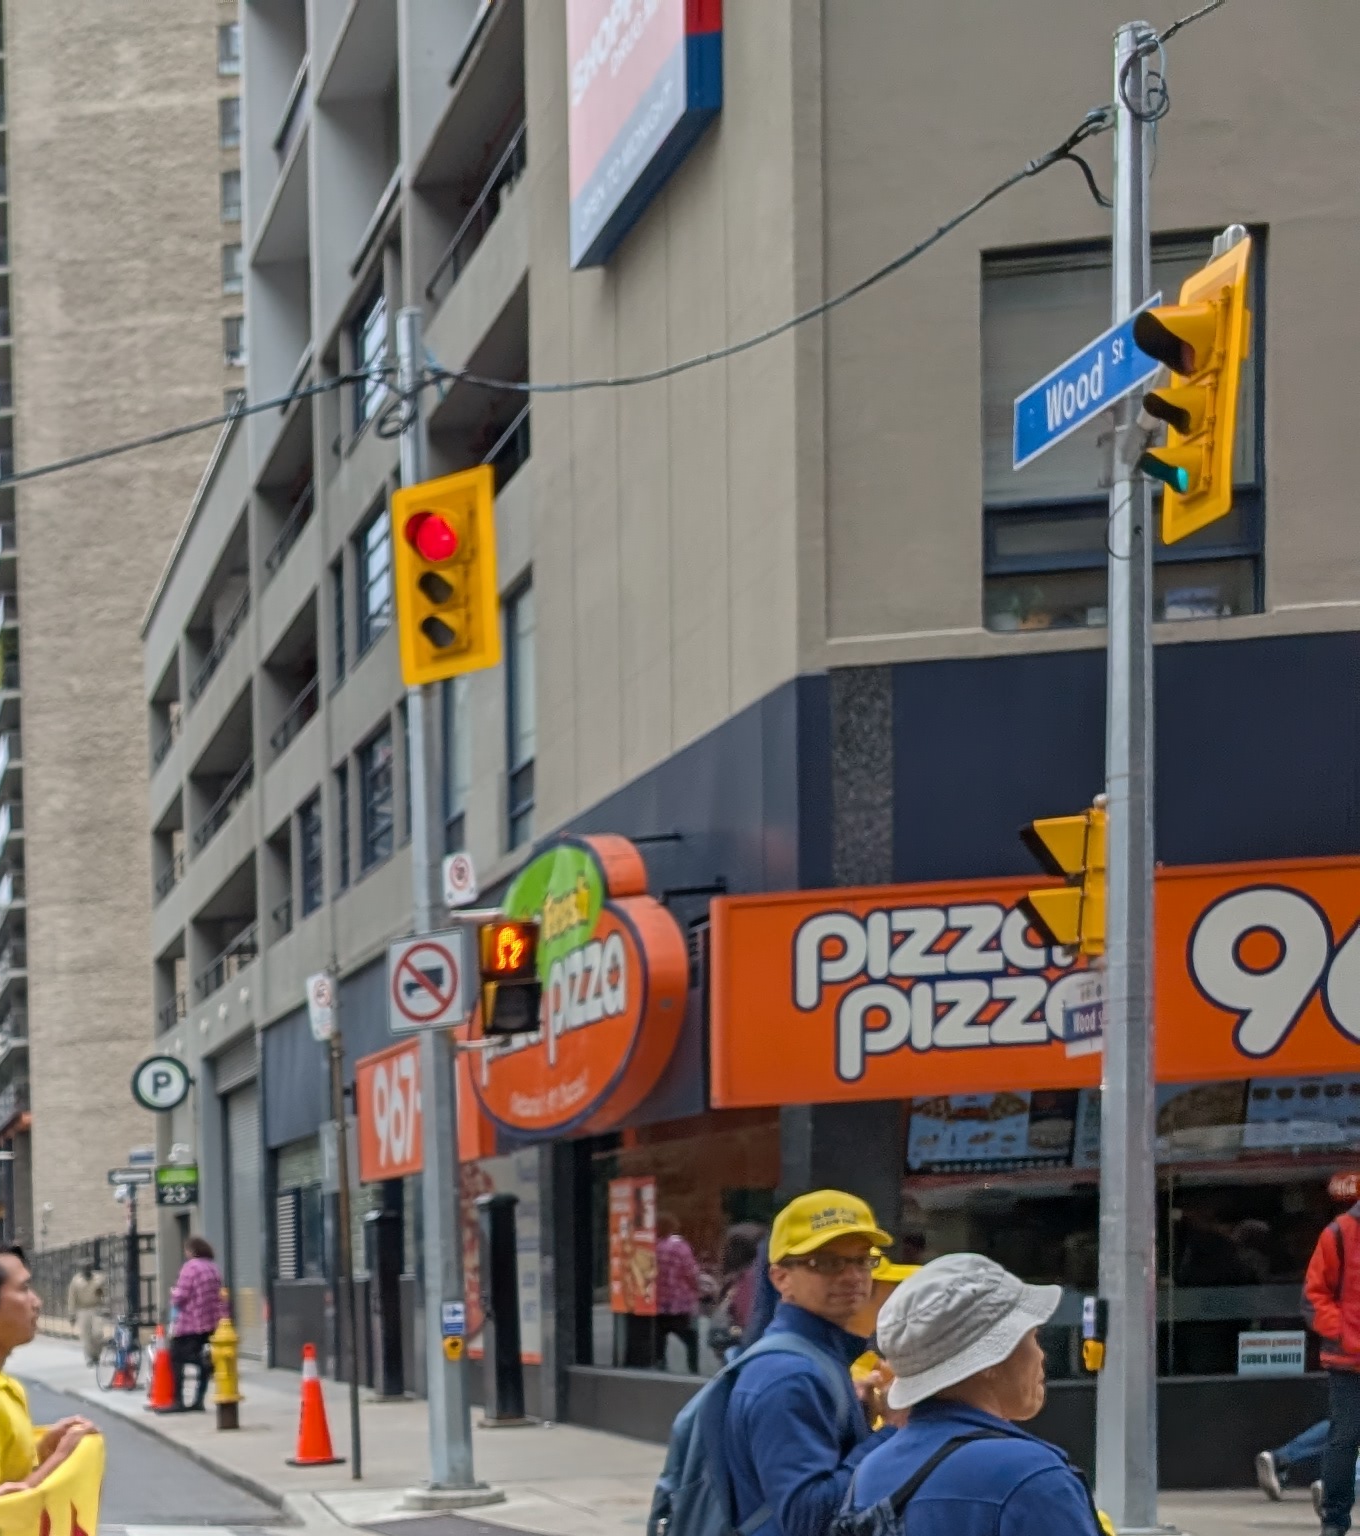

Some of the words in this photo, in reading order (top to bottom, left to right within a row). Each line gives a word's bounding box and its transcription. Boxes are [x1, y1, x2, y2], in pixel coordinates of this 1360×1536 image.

[1045, 350, 1104, 432] Wood
[1111, 337, 1125, 365] St
[1187, 884, 1360, 1058] 9
[151, 1071, 172, 1098] P
